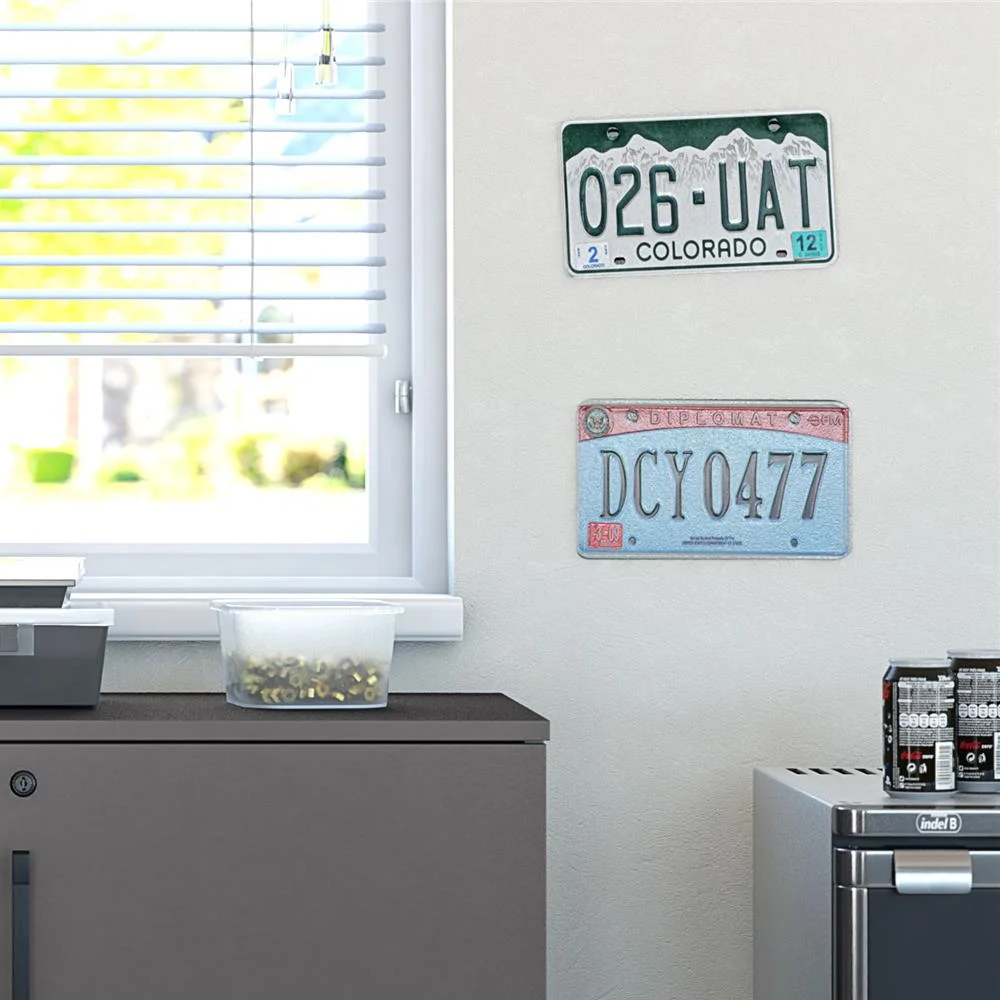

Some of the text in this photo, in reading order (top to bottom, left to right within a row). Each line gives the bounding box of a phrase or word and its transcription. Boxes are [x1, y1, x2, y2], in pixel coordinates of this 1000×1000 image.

[636, 237, 767, 261] COLORADO
[796, 234, 817, 251] 12
[588, 246, 599, 263] 2
[649, 412, 778, 426] DIPLOMAT
[599, 450, 828, 520] DCY0477
[920, 816, 958, 830] indel B
